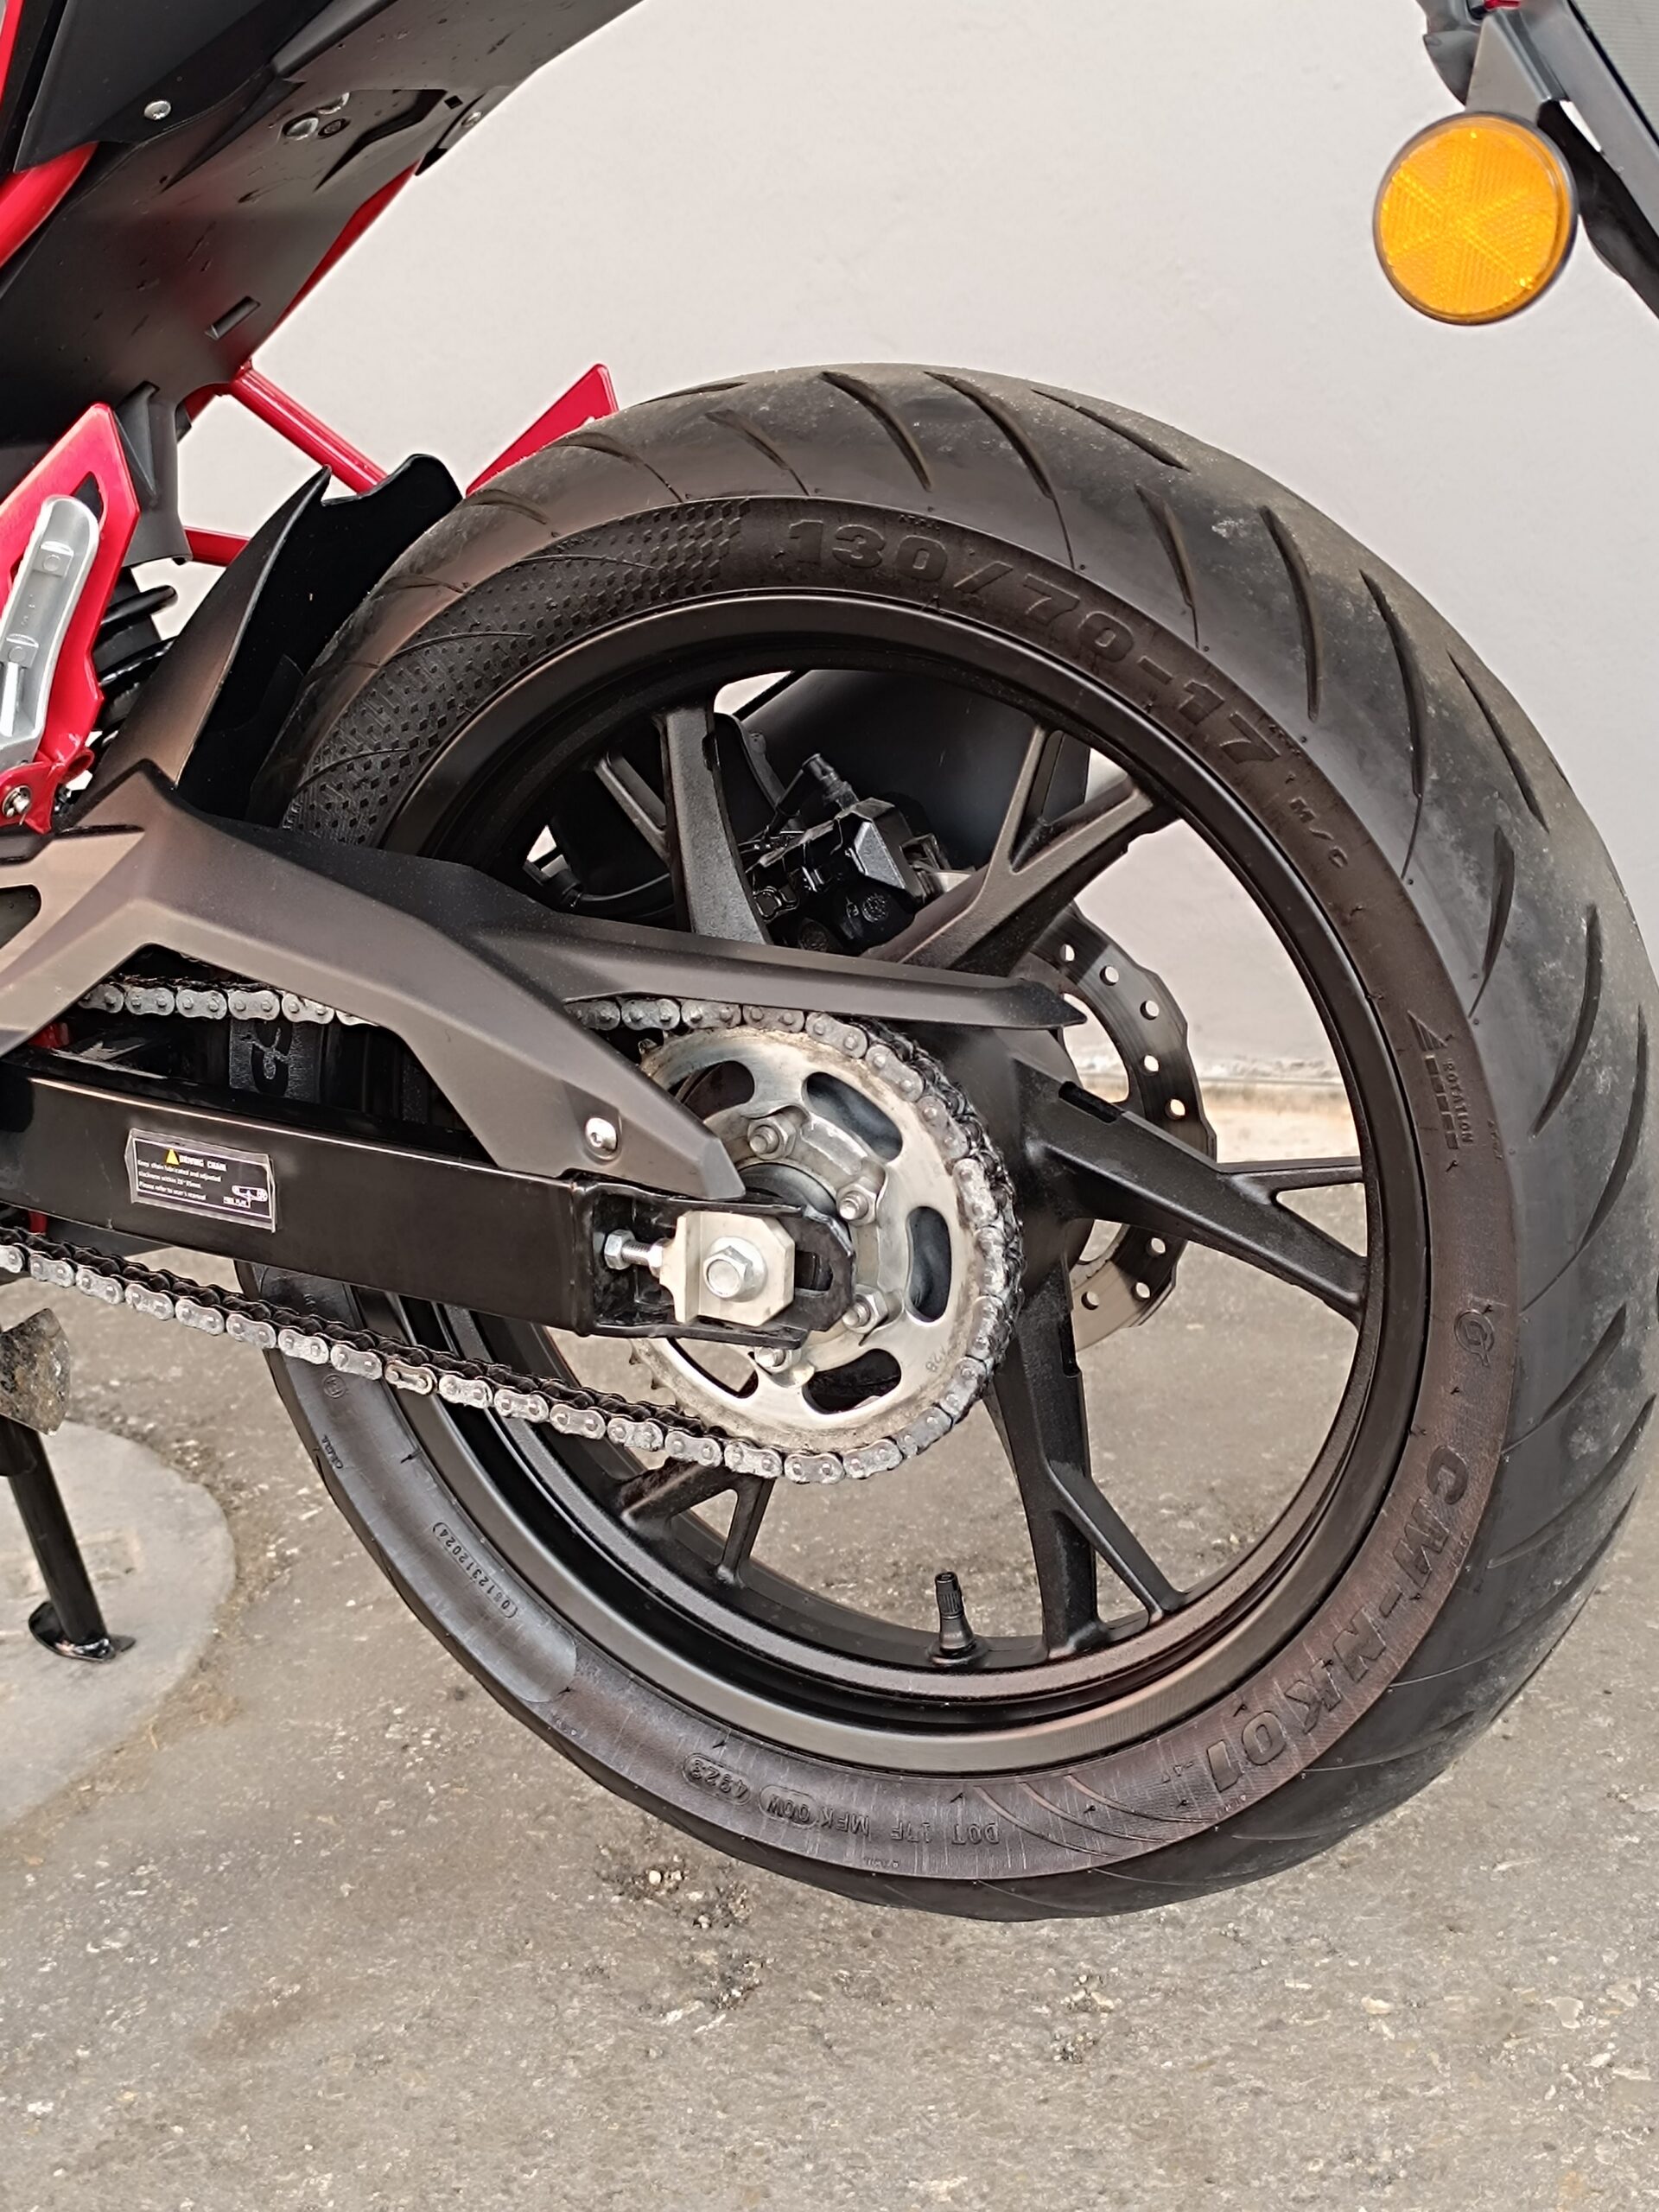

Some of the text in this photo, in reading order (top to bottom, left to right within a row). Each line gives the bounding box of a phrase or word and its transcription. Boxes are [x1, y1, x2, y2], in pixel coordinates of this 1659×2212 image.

[787, 518, 1282, 765] 130/70-17
[1442, 1059, 1474, 1144] ROTATION
[690, 1758, 749, 1804] 4923
[952, 1823, 1000, 1845] DOT
